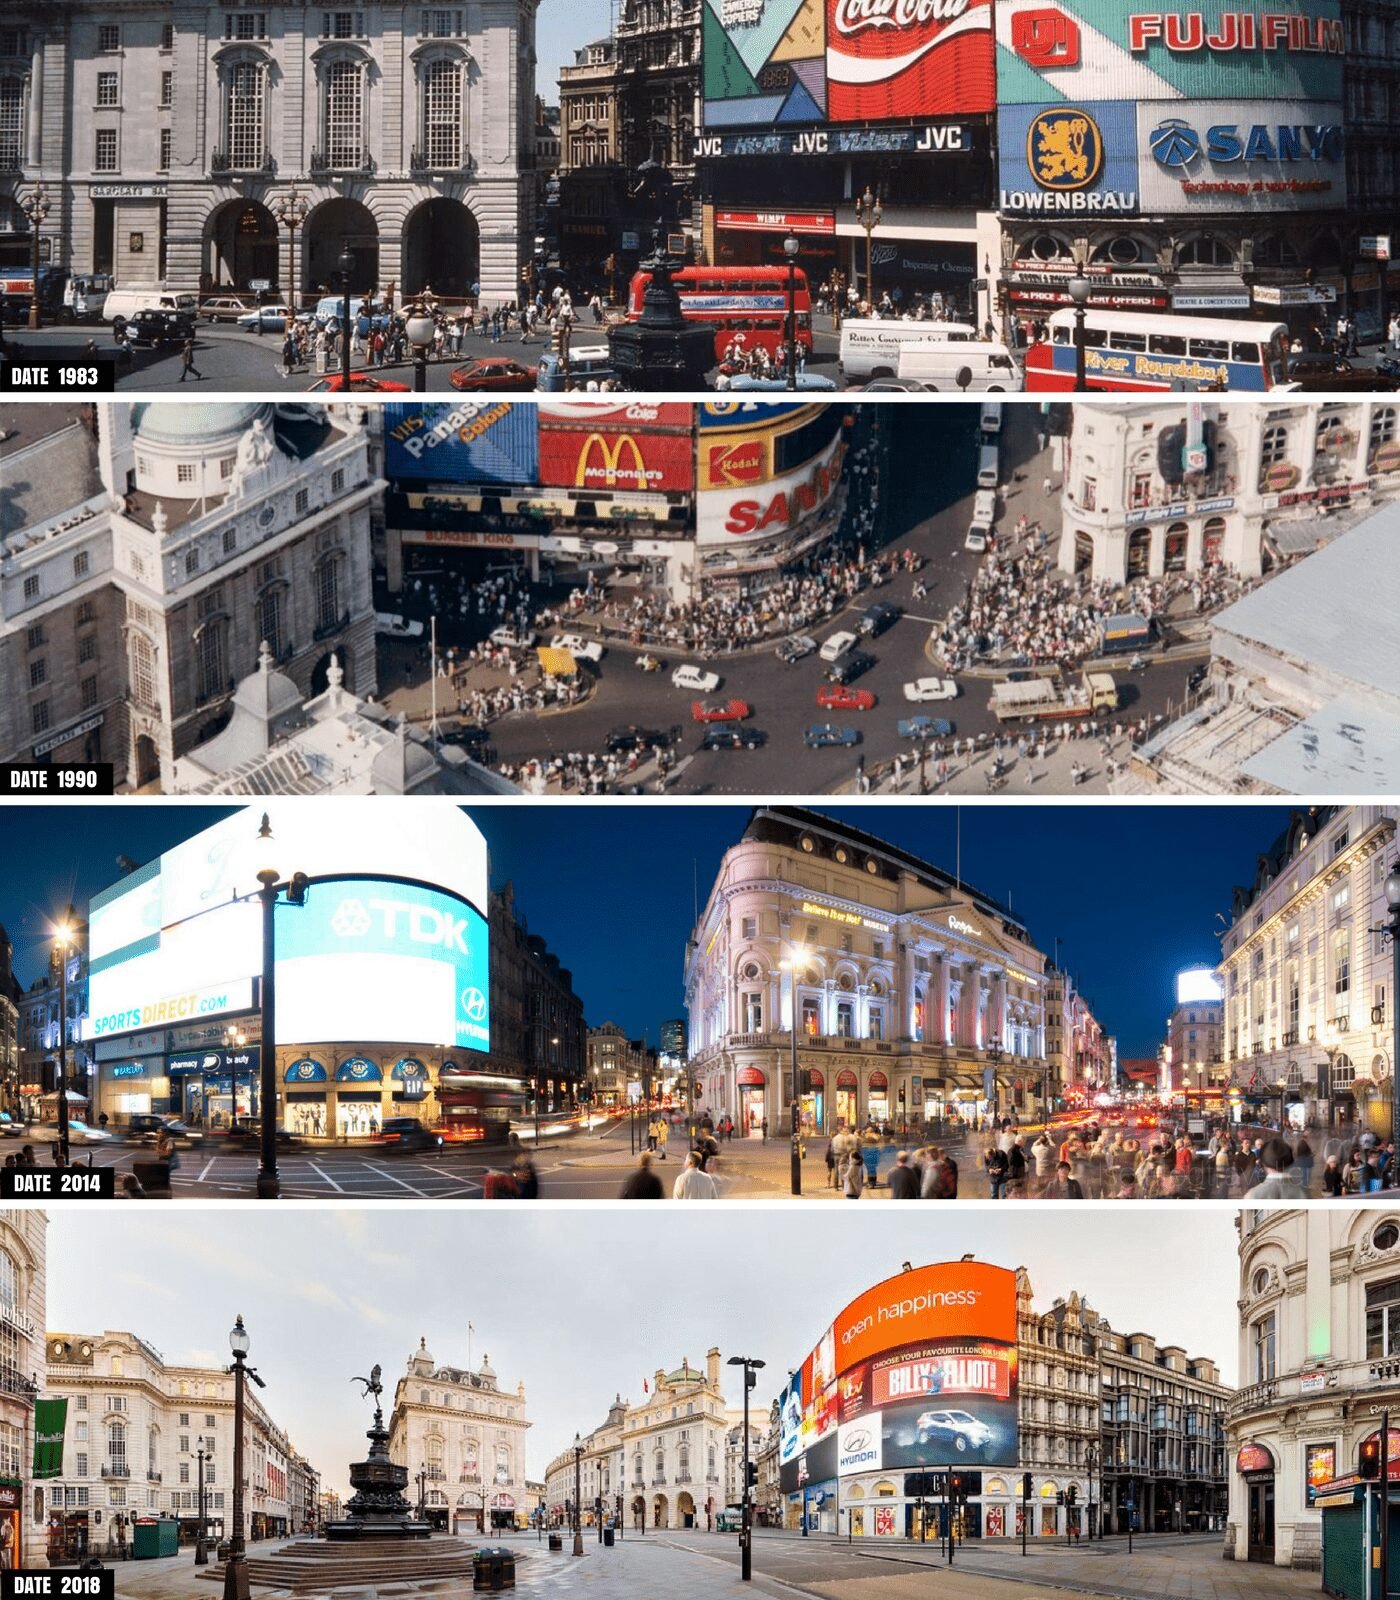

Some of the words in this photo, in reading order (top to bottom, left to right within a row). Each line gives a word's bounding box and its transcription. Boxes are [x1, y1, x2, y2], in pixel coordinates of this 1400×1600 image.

[693, 137, 723, 156] JVC
[792, 132, 829, 152] JVC
[917, 126, 963, 150] JVC
[92, 185, 144, 197] BARCLAYS
[757, 213, 787, 225] WIMPY
[1030, 292, 1055, 302] PRICE
[849, 332, 875, 342] Ritter
[1136, 355, 1229, 383] Roundabout
[626, 407, 658, 421] Coke
[390, 416, 425, 441] VHS
[723, 457, 760, 470] Kodak
[585, 467, 664, 483] McDonald's
[425, 531, 479, 545] BURGER
[484, 532, 514, 545] KING
[372, 898, 469, 956] TDK
[170, 1059, 198, 1073] pharmacy
[226, 1053, 250, 1067] bauty
[406, 1080, 421, 1094] GAP
[842, 1314, 874, 1345] open
[878, 1290, 976, 1322] happiness
[902, 1351, 922, 1362] YOUR
[923, 1347, 963, 1358] FAVOURITE
[965, 1347, 993, 1356] LONDON
[889, 1362, 930, 1397] BILLY
[840, 1450, 878, 1468] HYUNDAI
[877, 1507, 893, 1519] 50
[989, 1507, 1003, 1519] 50
